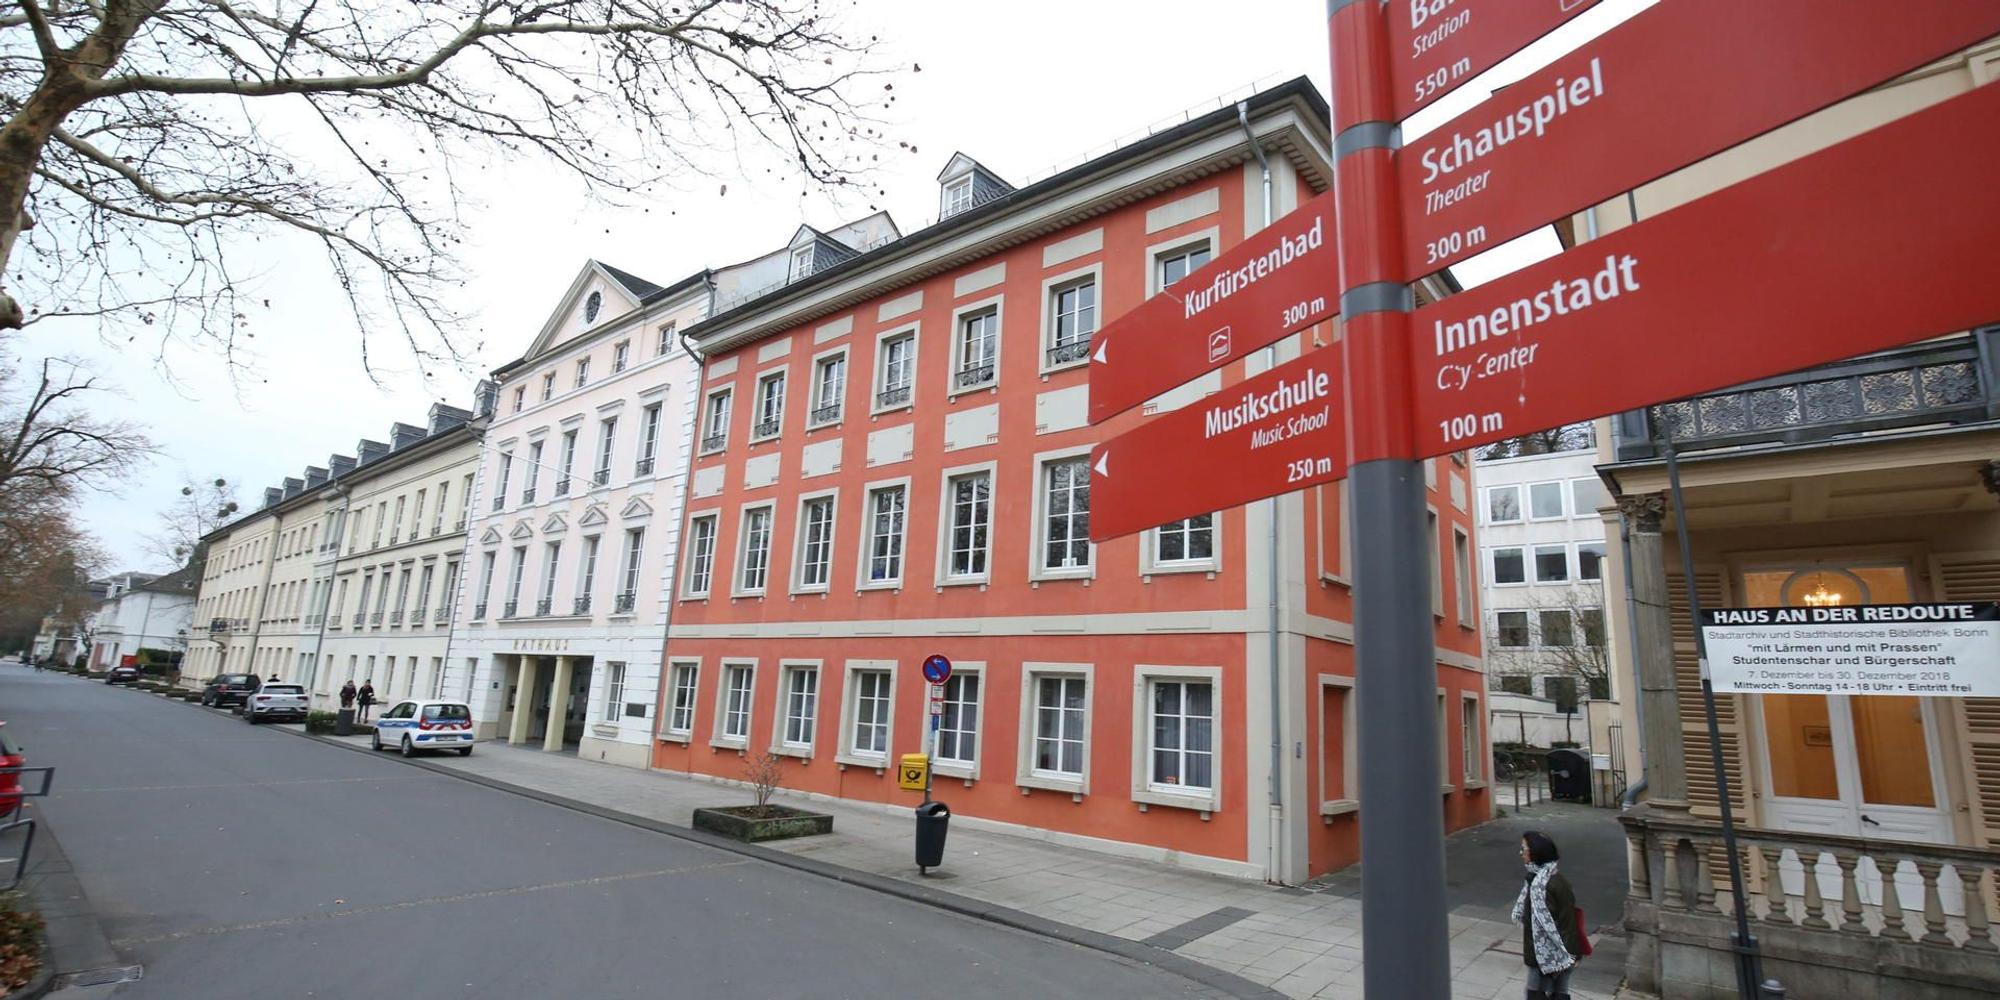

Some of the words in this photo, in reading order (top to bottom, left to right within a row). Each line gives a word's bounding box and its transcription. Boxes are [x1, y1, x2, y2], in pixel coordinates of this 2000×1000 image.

[1410, 0, 1454, 29] Ba
[1412, 9, 1470, 58] Station
[1414, 67, 1447, 102] 550
[1452, 56, 1471, 79] m
[1421, 57, 1604, 185] Schauspiel
[1425, 169, 1491, 216] Theater
[1425, 231, 1462, 264] 300
[1466, 225, 1486, 248] m
[1184, 216, 1322, 319] Kurfürstenbad
[1282, 307, 1308, 328] 300
[1310, 296, 1325, 315] m
[1434, 254, 1640, 356] Innenstadt
[1205, 368, 1329, 439] Musikschule
[1250, 423, 1285, 450] Music
[1286, 404, 1329, 438] School
[1439, 413, 1477, 443] 100
[1482, 411, 1503, 433] m
[1287, 457, 1313, 483] 250
[1316, 457, 1332, 475] m
[1713, 610, 1769, 624] HAUS
[1775, 608, 1808, 622] AN
[1813, 607, 1858, 621] DER
[1863, 605, 1975, 620] REDOUTE
[1708, 631, 1767, 640] Stadtarchiv
[1769, 630, 1791, 639] und
[1794, 630, 1886, 640] Stadthistorische
[1889, 629, 1950, 638] Bibliothek
[1954, 628, 1989, 637] Bonn
[1775, 643, 1822, 653] Lärmen
[1826, 643, 1851, 653] und
[1855, 643, 1876, 652] mit
[1733, 656, 1830, 665] Studentenschar
[1835, 656, 1860, 665] und
[1864, 655, 1957, 667] Bürgerschaft
[1761, 670, 1815, 680] Dezember
[1818, 670, 1834, 680] bis
[1858, 670, 1917, 680] Dezember
[1920, 671, 1951, 681] 2018
[1734, 682, 1780, 690] Mittwoch
[1787, 682, 1832, 692] Sonntag
[1873, 683, 1893, 691] Uhr
[1907, 683, 1948, 692] Eintritt
[1952, 683, 1972, 692] frei
